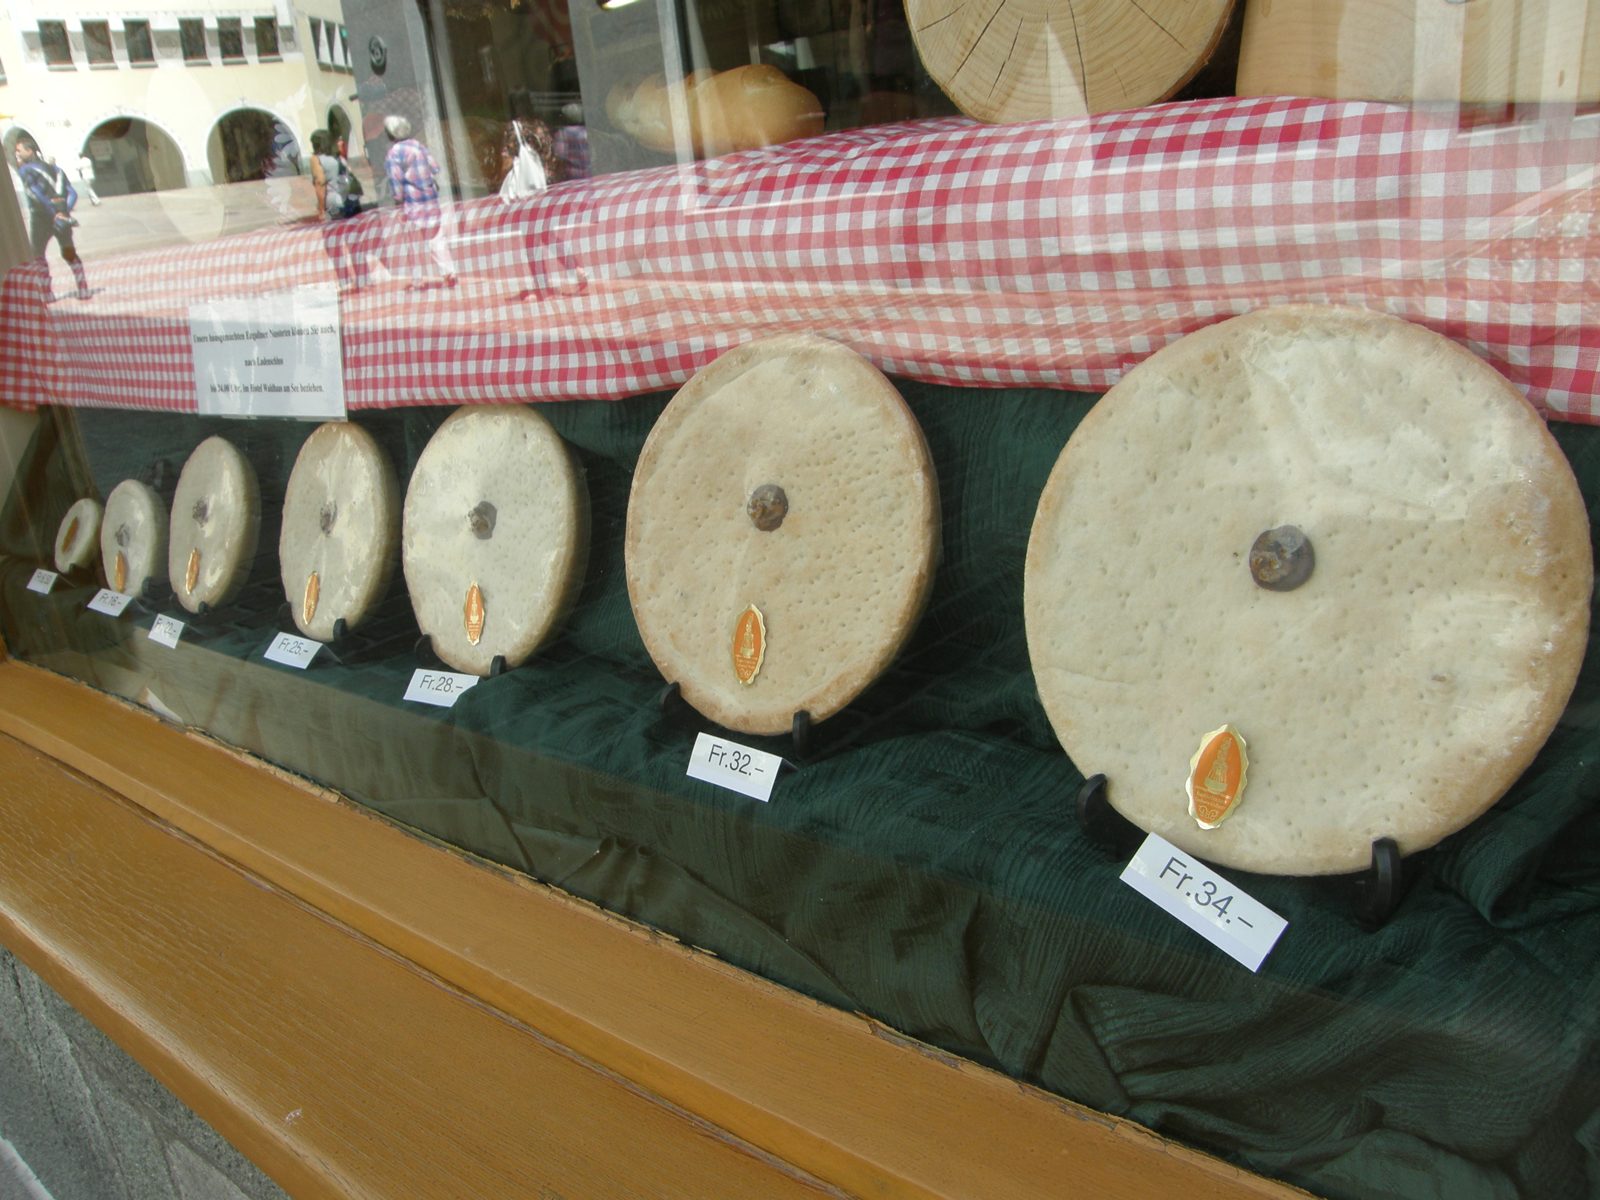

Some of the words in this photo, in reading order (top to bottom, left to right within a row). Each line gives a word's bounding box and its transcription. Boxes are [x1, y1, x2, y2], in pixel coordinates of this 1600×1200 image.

[419, 674, 463, 693] Fr.28.-
[708, 743, 764, 776] Fr.32.-
[1159, 856, 1253, 928] Fr.34.-
